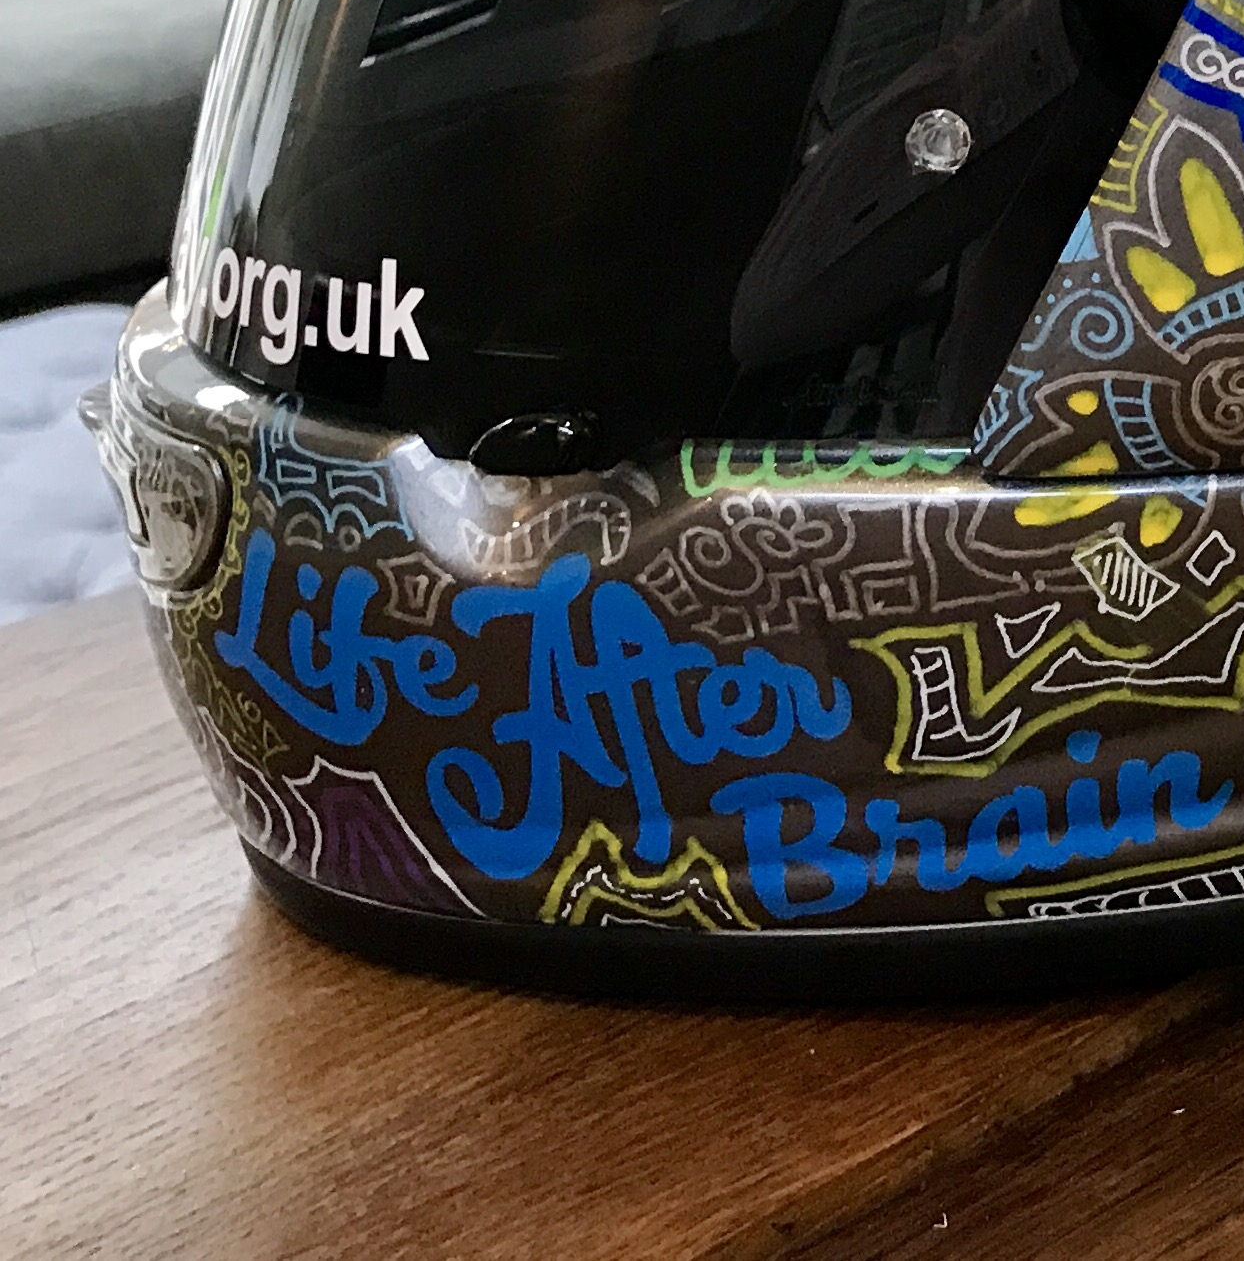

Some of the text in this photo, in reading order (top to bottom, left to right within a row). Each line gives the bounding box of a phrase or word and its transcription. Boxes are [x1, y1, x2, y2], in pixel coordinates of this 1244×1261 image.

[215, 526, 853, 881] Life After
[709, 729, 1234, 920] Brain
